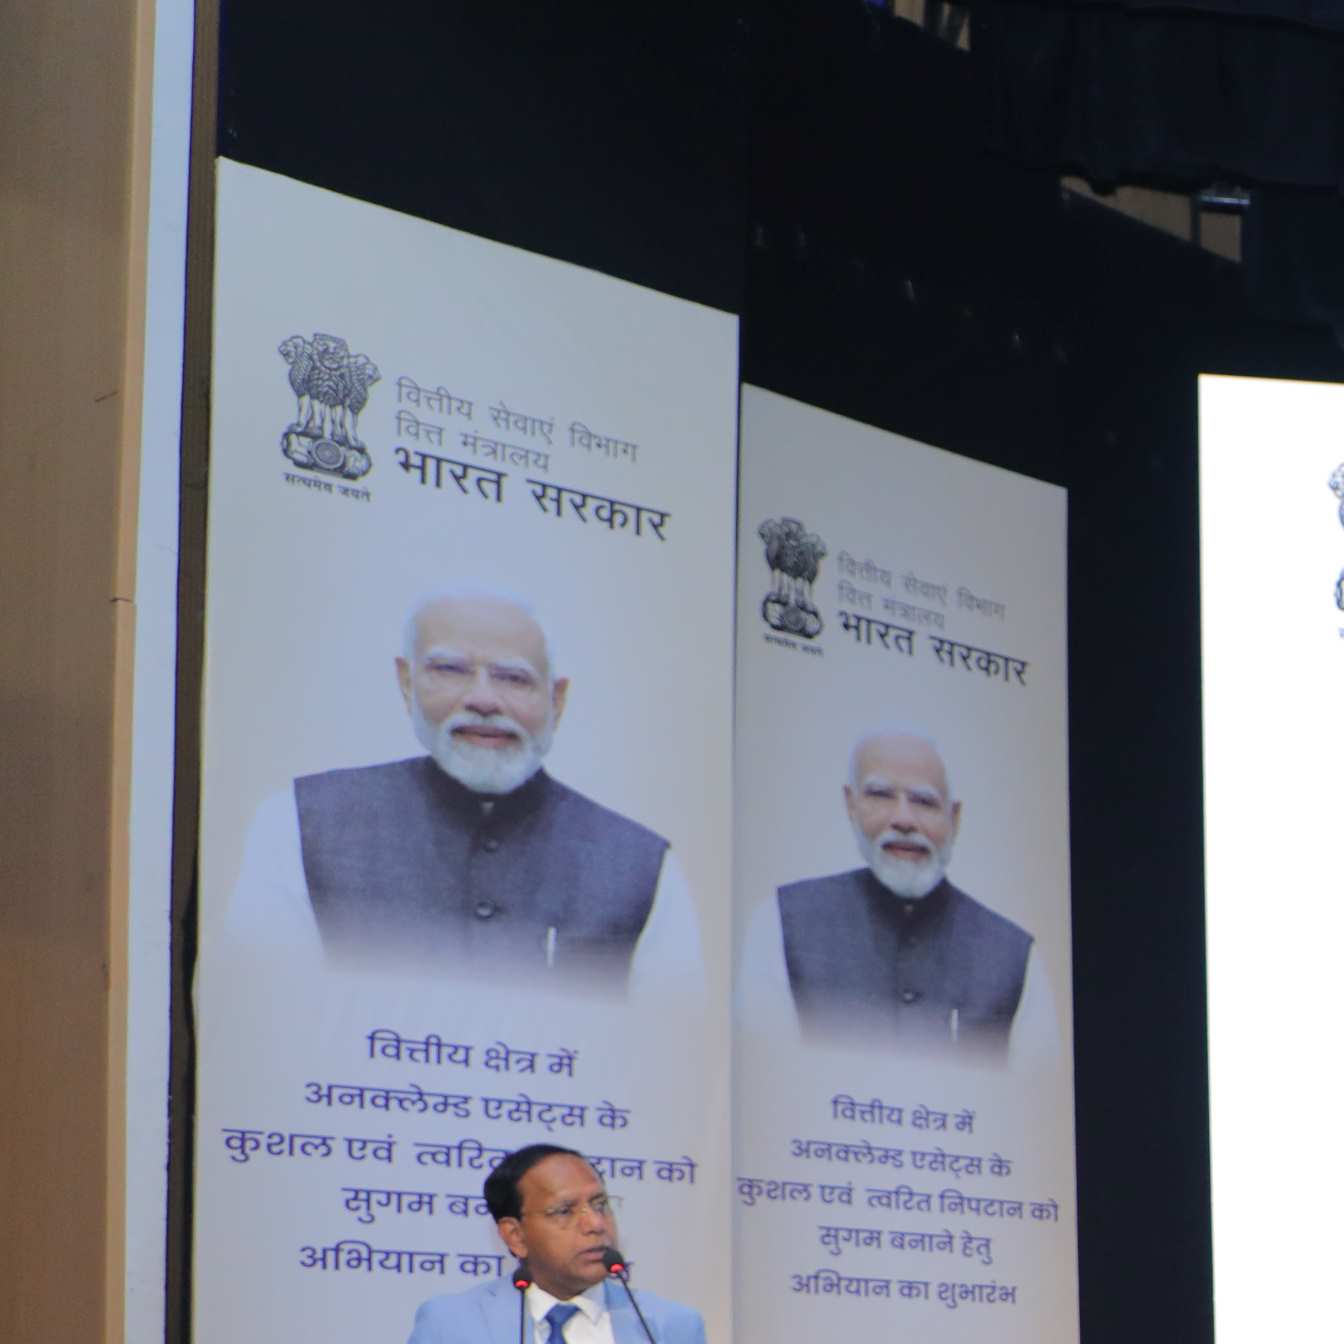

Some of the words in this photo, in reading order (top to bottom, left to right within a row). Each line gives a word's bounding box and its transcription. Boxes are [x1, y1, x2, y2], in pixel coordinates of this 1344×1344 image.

[395, 410, 445, 447] वित्त
[460, 426, 550, 472] मंत्रालय
[397, 376, 473, 420] वित्तीय
[489, 401, 555, 445] सेवाएं
[568, 423, 639, 462] विभाग
[394, 445, 508, 503] भारत
[526, 477, 671, 540] सरकार
[838, 610, 916, 656] भारत
[930, 635, 1029, 686] सरकार
[366, 1029, 472, 1068] वित्तीय
[484, 1040, 538, 1074] क्षेत्र
[547, 1048, 579, 1078] में
[304, 1080, 472, 1119] अनक्लेम्ड
[481, 1093, 587, 1132] एसेट्स
[597, 1101, 630, 1130] के
[221, 1127, 336, 1164] कुशल
[344, 1133, 397, 1164] एवं
[654, 1156, 698, 1185] को
[341, 1186, 435, 1224] सुगम
[299, 1240, 446, 1276] अभियान
[457, 1253, 505, 1277] का
